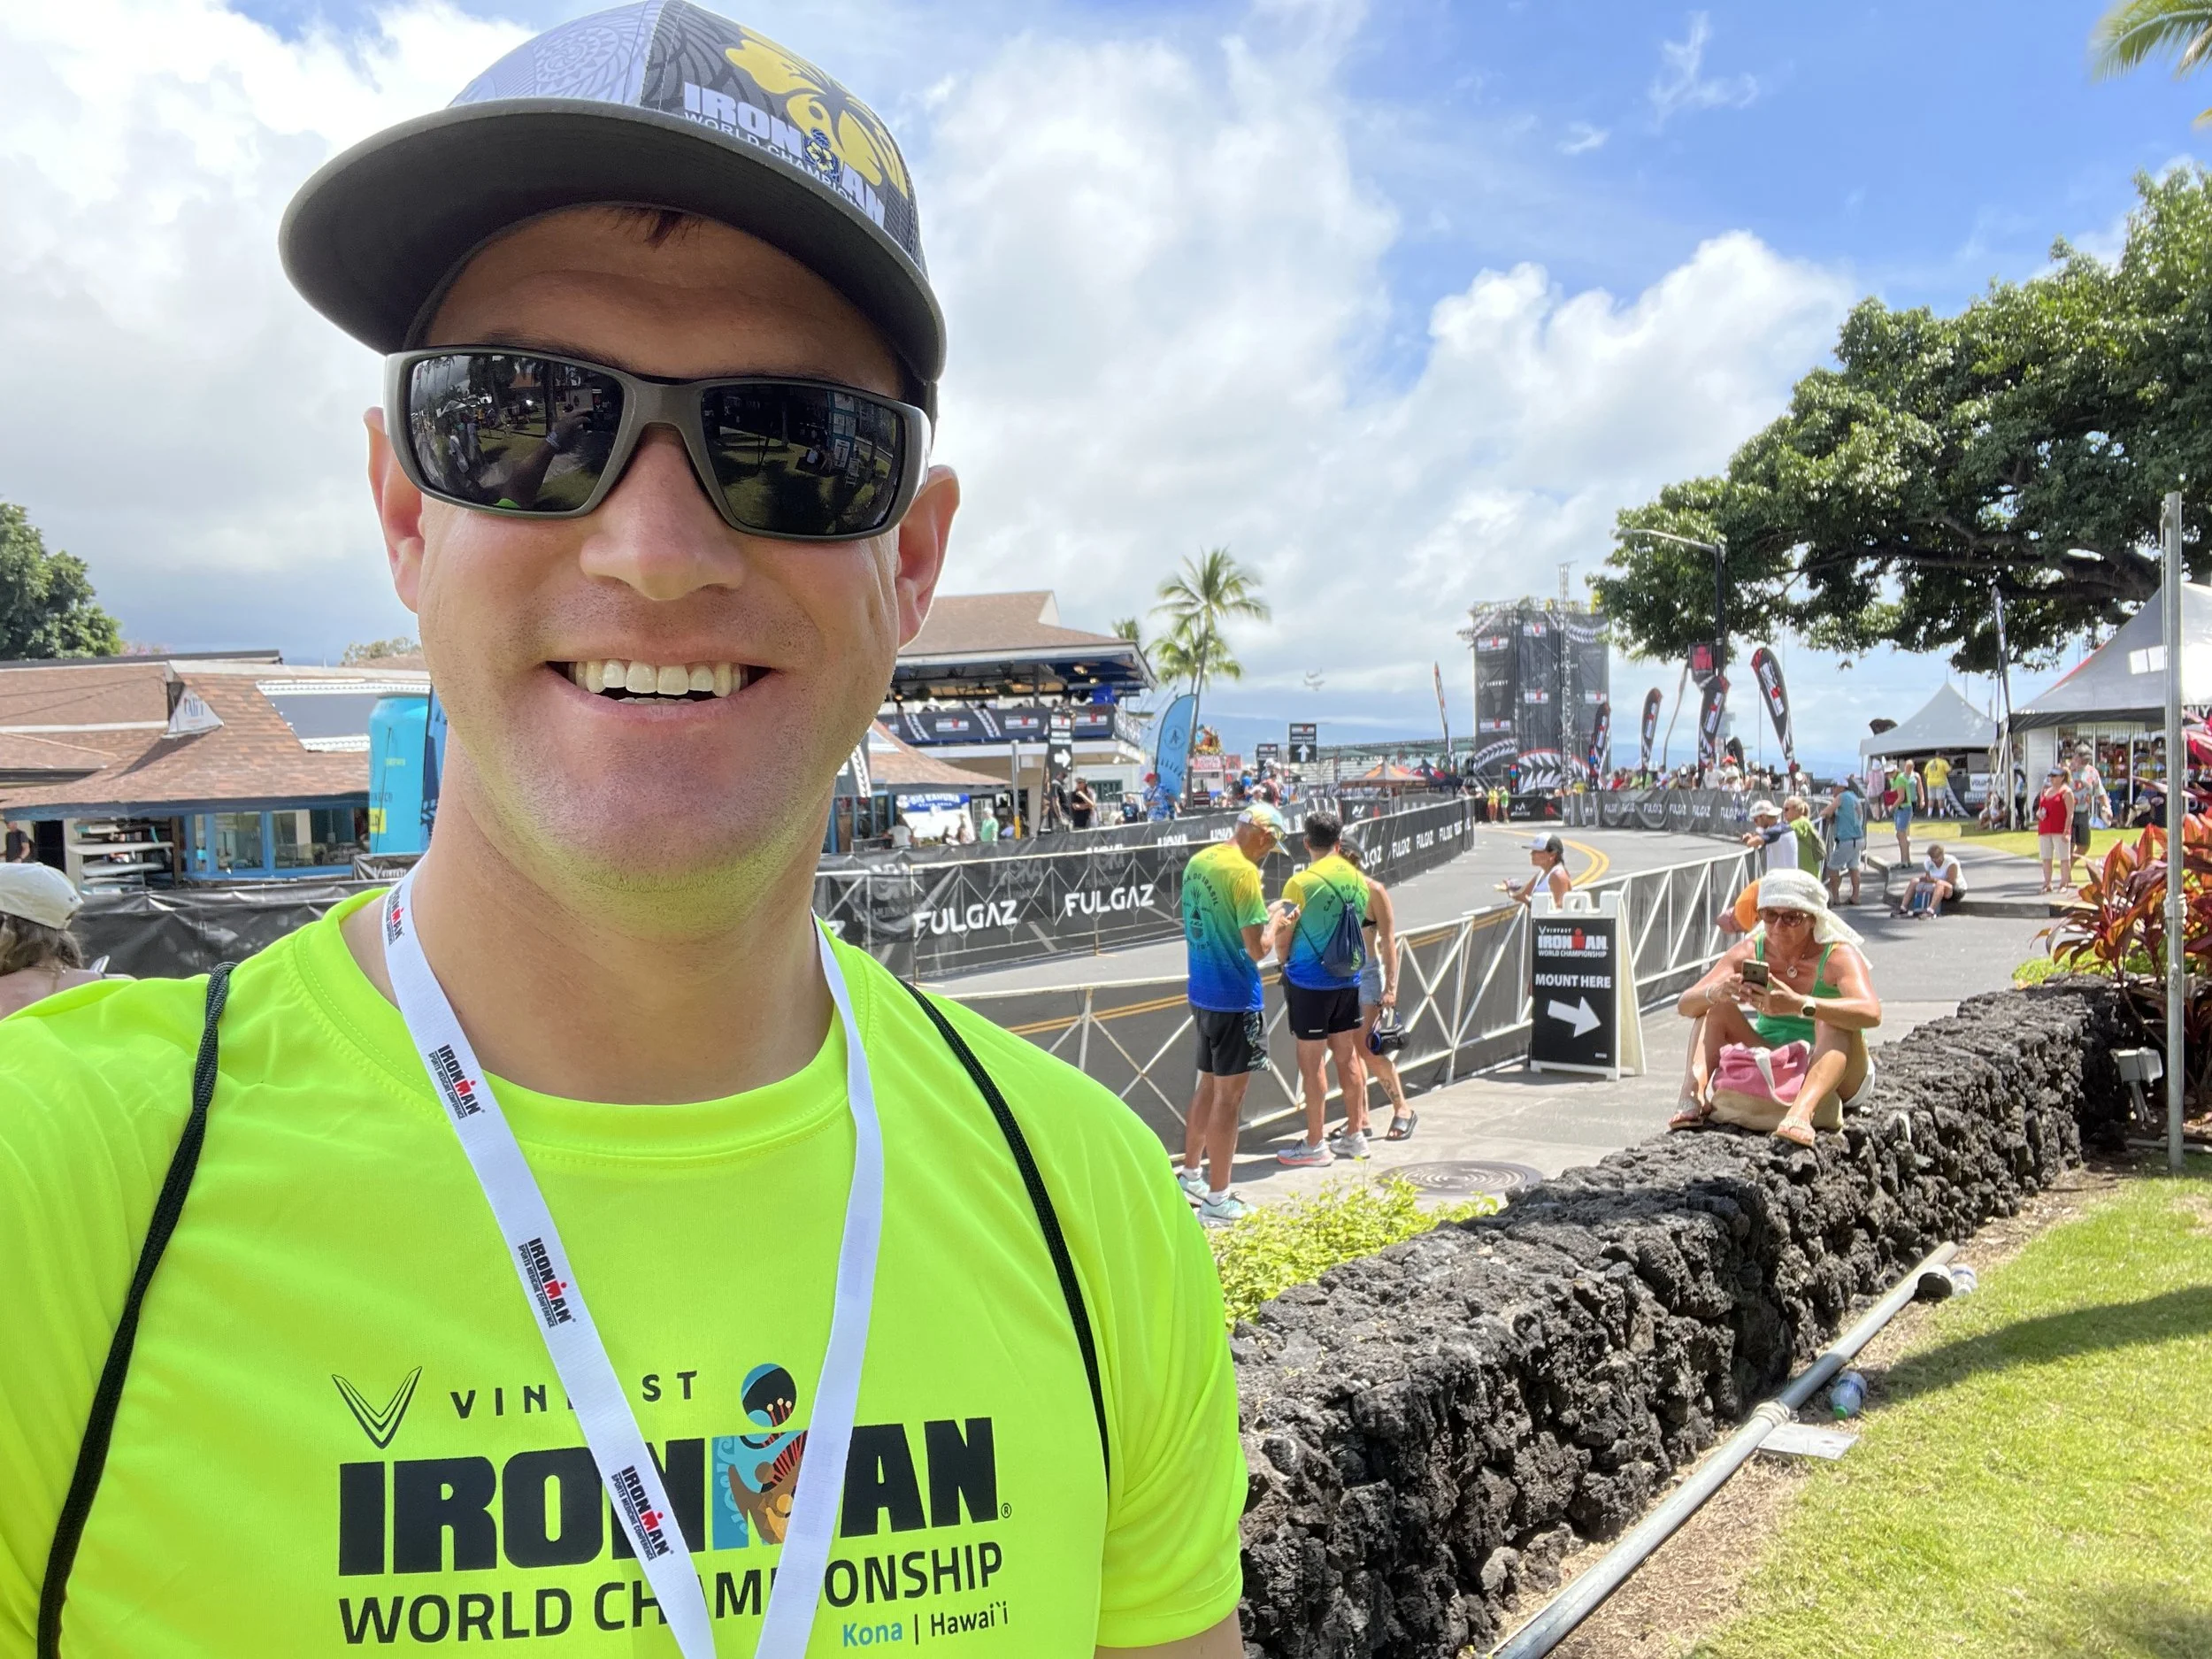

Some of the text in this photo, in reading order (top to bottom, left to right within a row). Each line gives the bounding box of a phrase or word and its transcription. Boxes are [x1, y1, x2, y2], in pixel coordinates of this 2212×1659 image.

[685, 112, 760, 146] WORLD
[913, 899, 1019, 938] FULGAZ
[1064, 884, 1155, 917] FULGAZ
[1538, 927, 1609, 950] IRONMAN
[1560, 949, 1608, 958] CHAMPIONSHIP
[1535, 973, 1611, 989] MOUNT HERE
[428, 1052, 441, 1071] SPORTS
[446, 1089, 466, 1120] CONFERENCE
[437, 1044, 481, 1117] IRONMAN
[518, 1244, 556, 1328] SPORTS MEDICINE CONFERENCE
[528, 1238, 572, 1324] IRONMAN
[450, 1371, 697, 1419] VINST
[611, 1473, 655, 1562] SPORTS MEDICINE CONFERENCE
[621, 1465, 670, 1556] IRONMAN
[339, 1588, 572, 1644] WORLD
[842, 1620, 902, 1647] Kona
